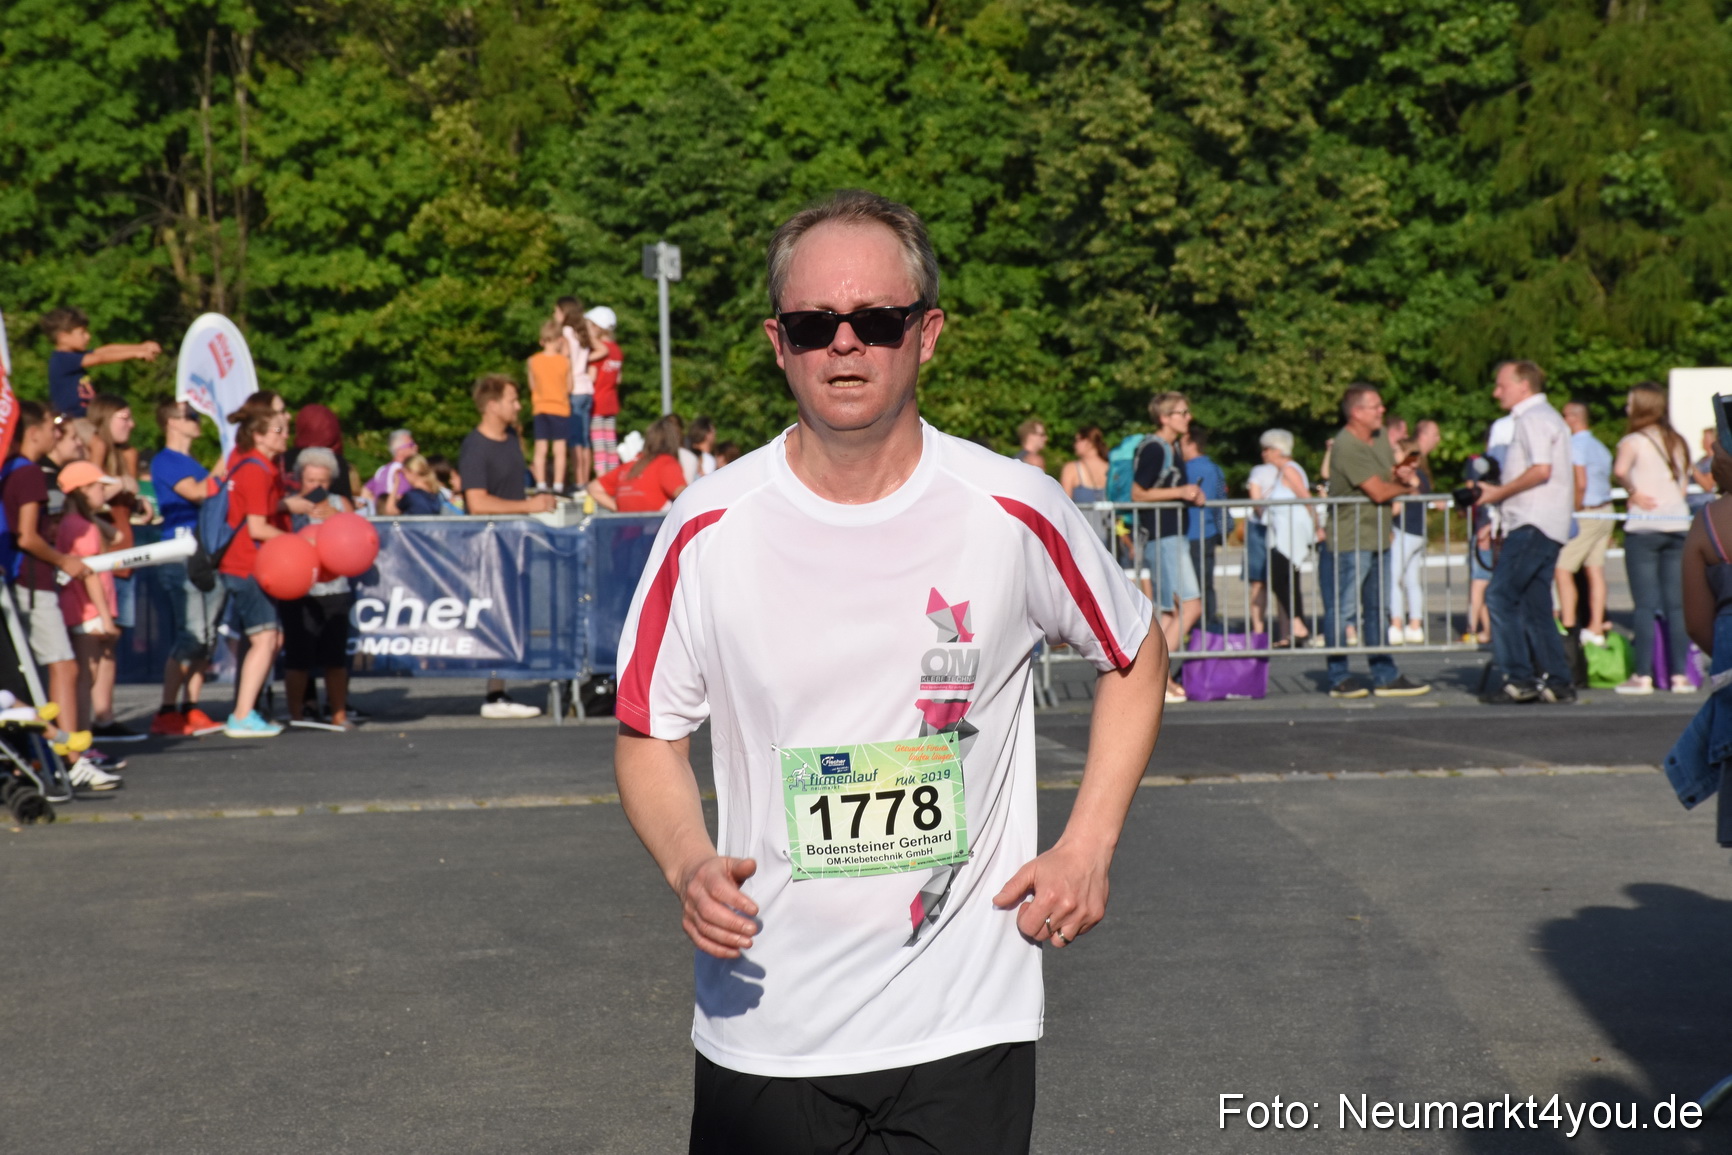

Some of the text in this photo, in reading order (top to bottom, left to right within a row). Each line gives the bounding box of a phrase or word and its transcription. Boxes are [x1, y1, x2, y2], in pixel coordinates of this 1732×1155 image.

[921, 648, 980, 676] OM
[810, 768, 879, 786] firmenlauf
[920, 768, 951, 784] 2019
[809, 784, 942, 841] 1778
[806, 830, 952, 856] Bodensteiner Gerhard
[826, 853, 904, 866] OM-Klebetechnik
[905, 846, 934, 860] GmbH
